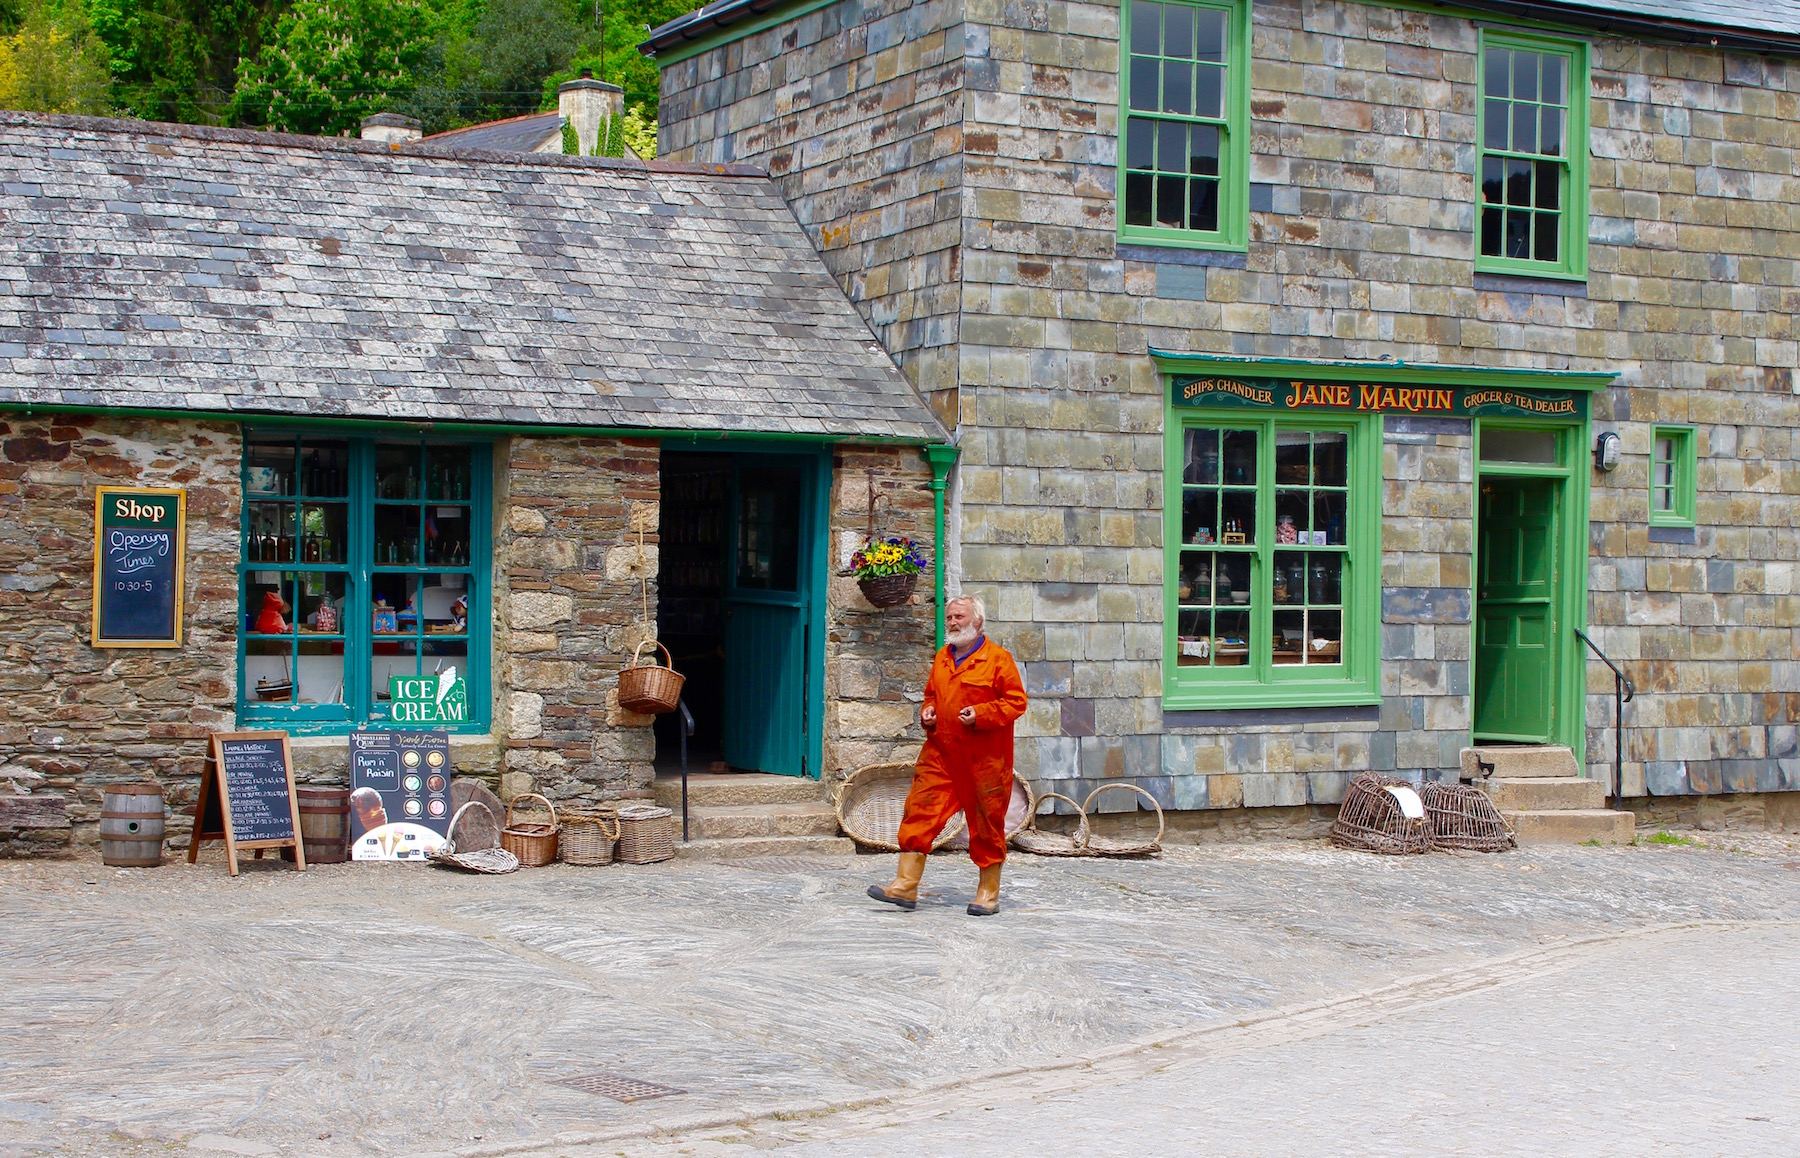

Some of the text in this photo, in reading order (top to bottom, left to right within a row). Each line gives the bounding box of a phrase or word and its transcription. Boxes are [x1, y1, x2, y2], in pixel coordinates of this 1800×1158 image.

[1217, 379, 1275, 404] CHANDLER
[1285, 381, 1454, 413] JANE MARTIN
[1463, 390, 1577, 414] GROCER & TEA DEALER
[115, 498, 165, 523] Shop
[110, 531, 170, 557] Opening
[116, 551, 155, 569] Times
[397, 680, 434, 699] ICE
[392, 702, 464, 722] CREAM
[357, 755, 376, 767] Rum
[366, 768, 394, 778] Raisin
